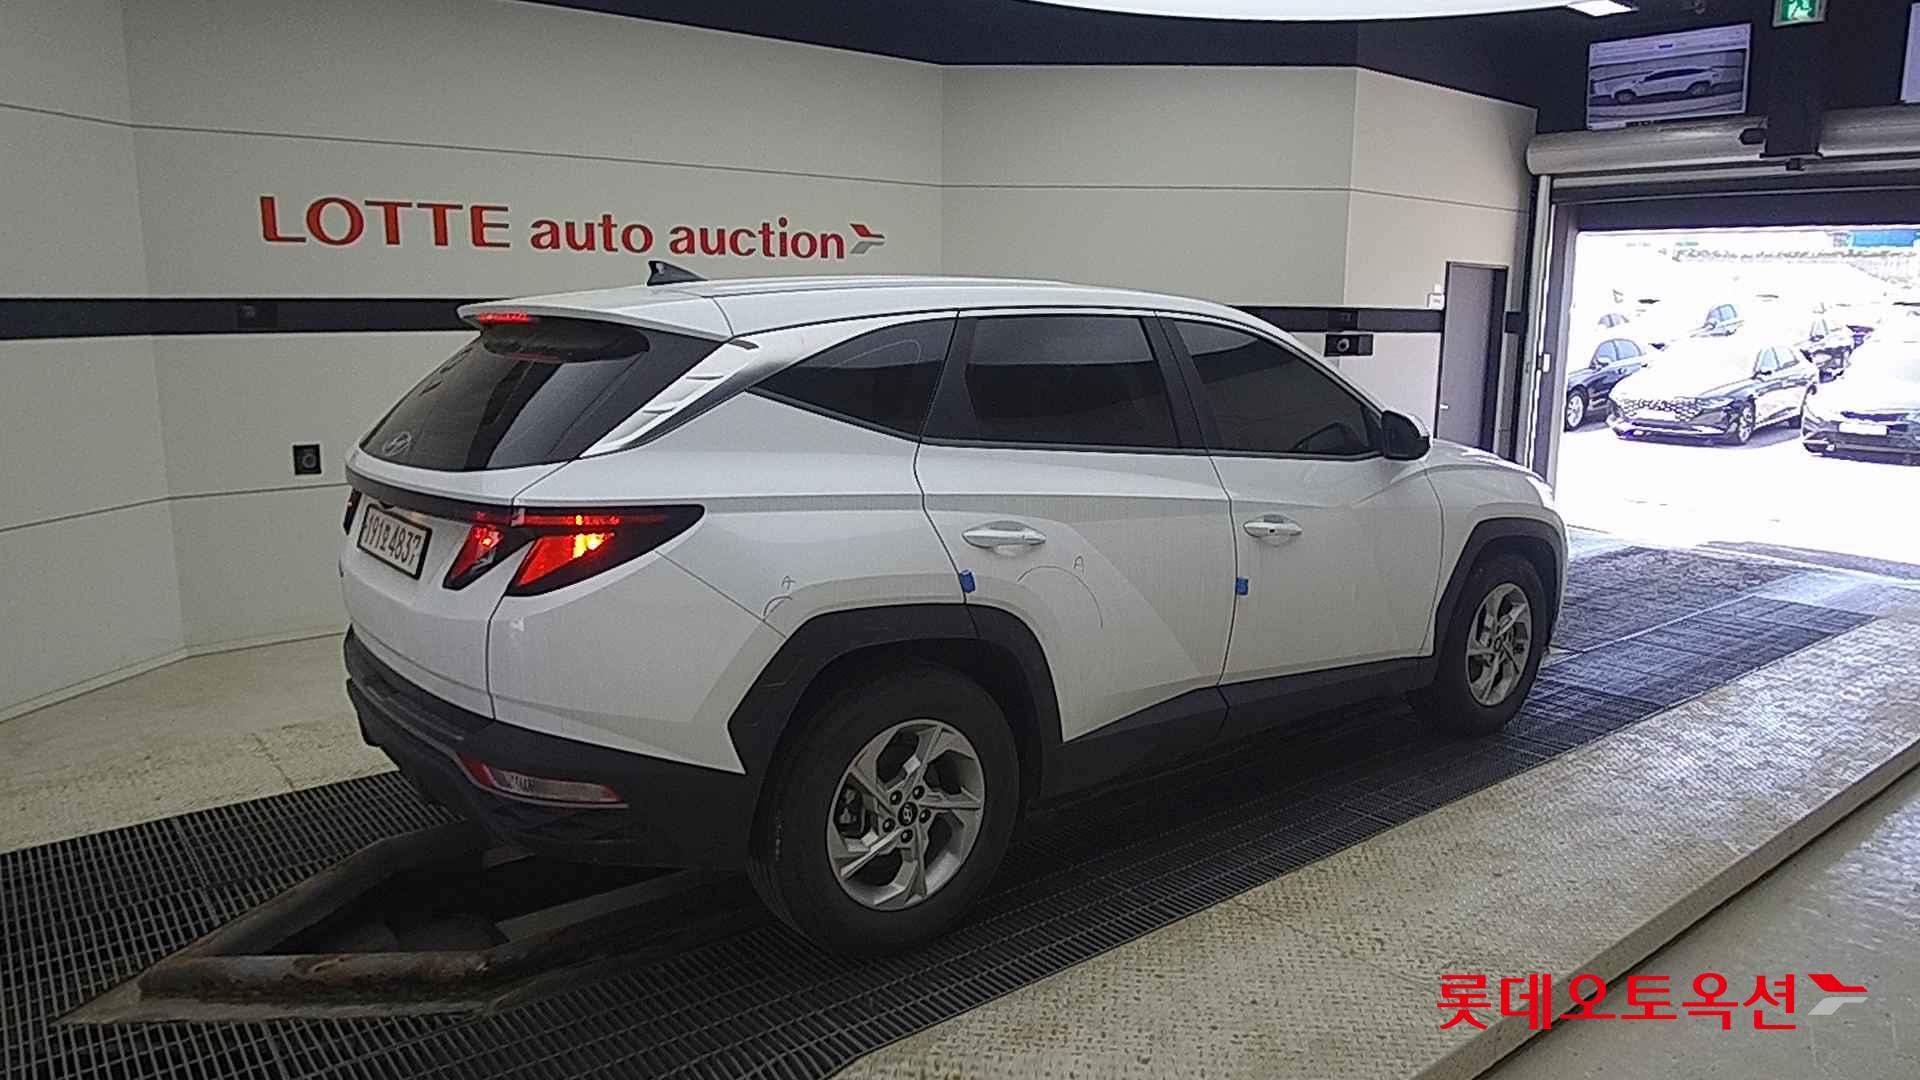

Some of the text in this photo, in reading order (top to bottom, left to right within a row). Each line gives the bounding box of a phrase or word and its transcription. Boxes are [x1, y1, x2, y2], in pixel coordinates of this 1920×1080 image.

[260, 196, 845, 259] LOTTE auto auction
